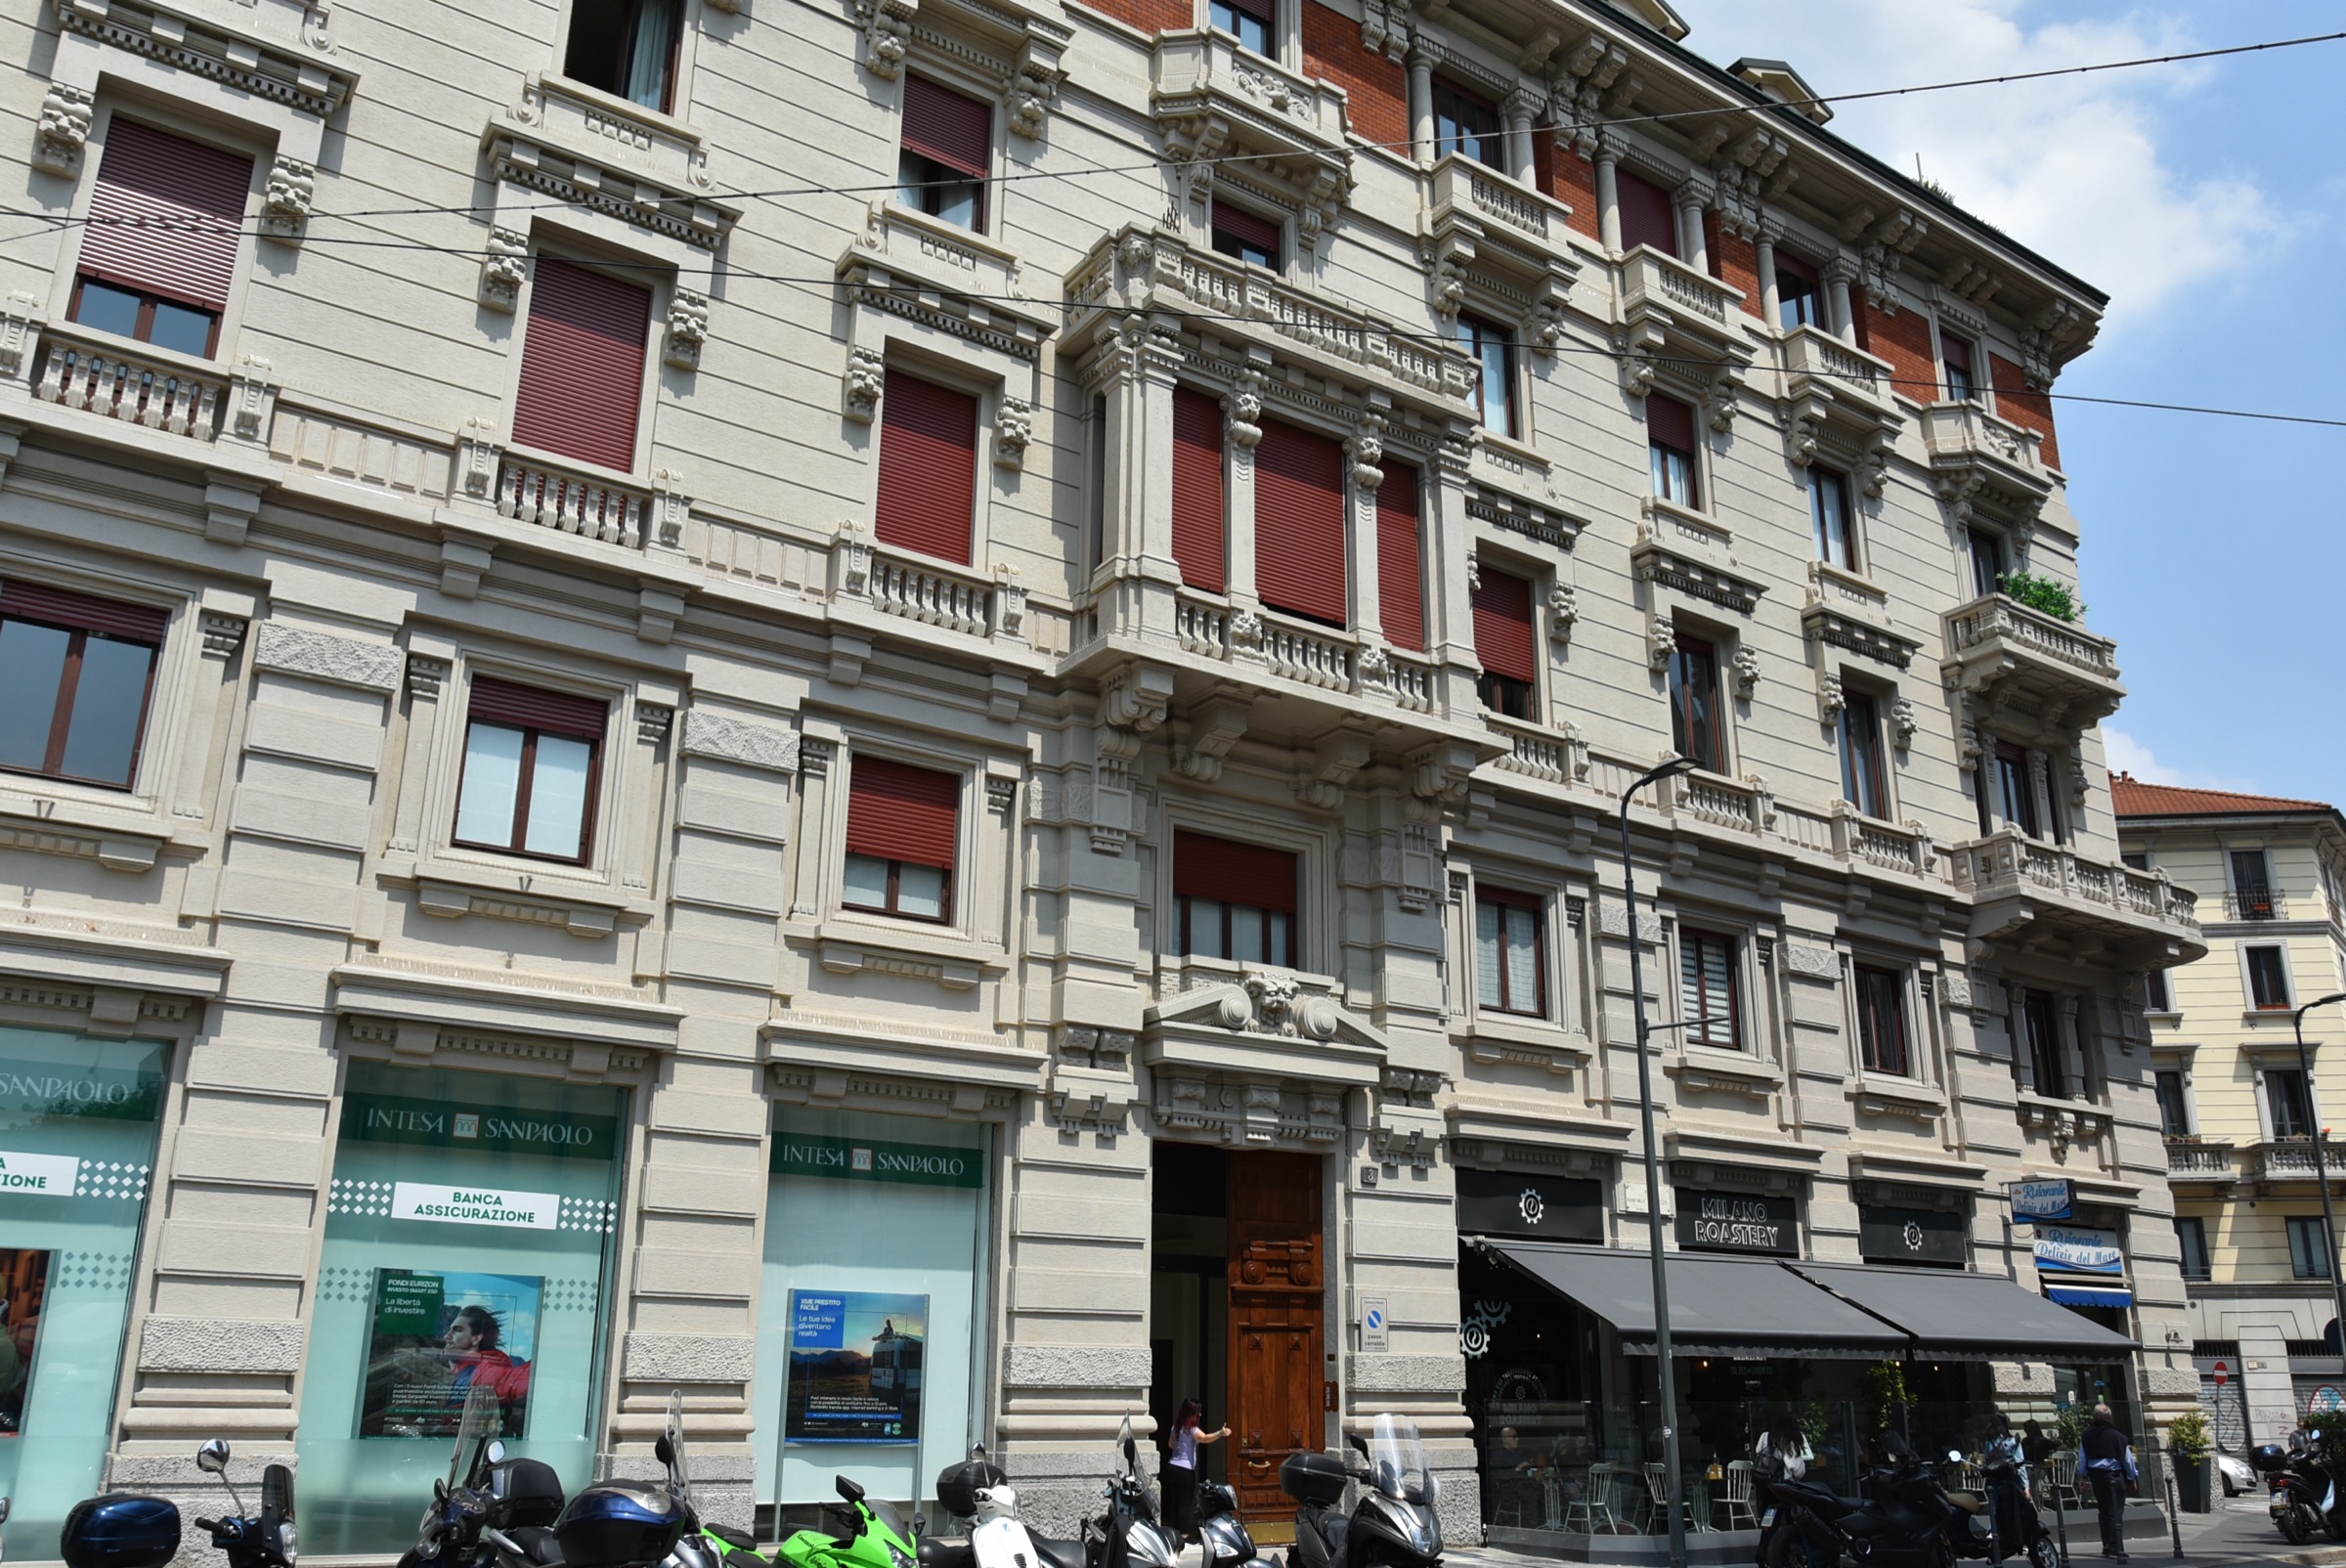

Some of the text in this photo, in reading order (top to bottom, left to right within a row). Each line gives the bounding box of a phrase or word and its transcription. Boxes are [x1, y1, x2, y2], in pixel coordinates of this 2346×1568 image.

[367, 1107, 593, 1147] INTESA SANPAOLO
[783, 1144, 965, 1176] INTESA SANPAOLO
[1367, 1168, 1374, 1181] 3
[453, 1191, 503, 1206] BANCA
[2023, 1183, 2065, 1199] Ristorante
[413, 1203, 536, 1224] ASSICURAZIONE
[1701, 1198, 1767, 1223] MILANO
[2015, 1198, 2066, 1213] Delizie del Mare
[1695, 1220, 1779, 1247] ROASTERY
[2049, 1229, 2103, 1247] Ristorante
[2036, 1241, 2116, 1265] Delizie del Mare
[410, 1280, 439, 1288] EURIZON
[396, 1297, 421, 1306] libertà
[393, 1306, 426, 1315] investire
